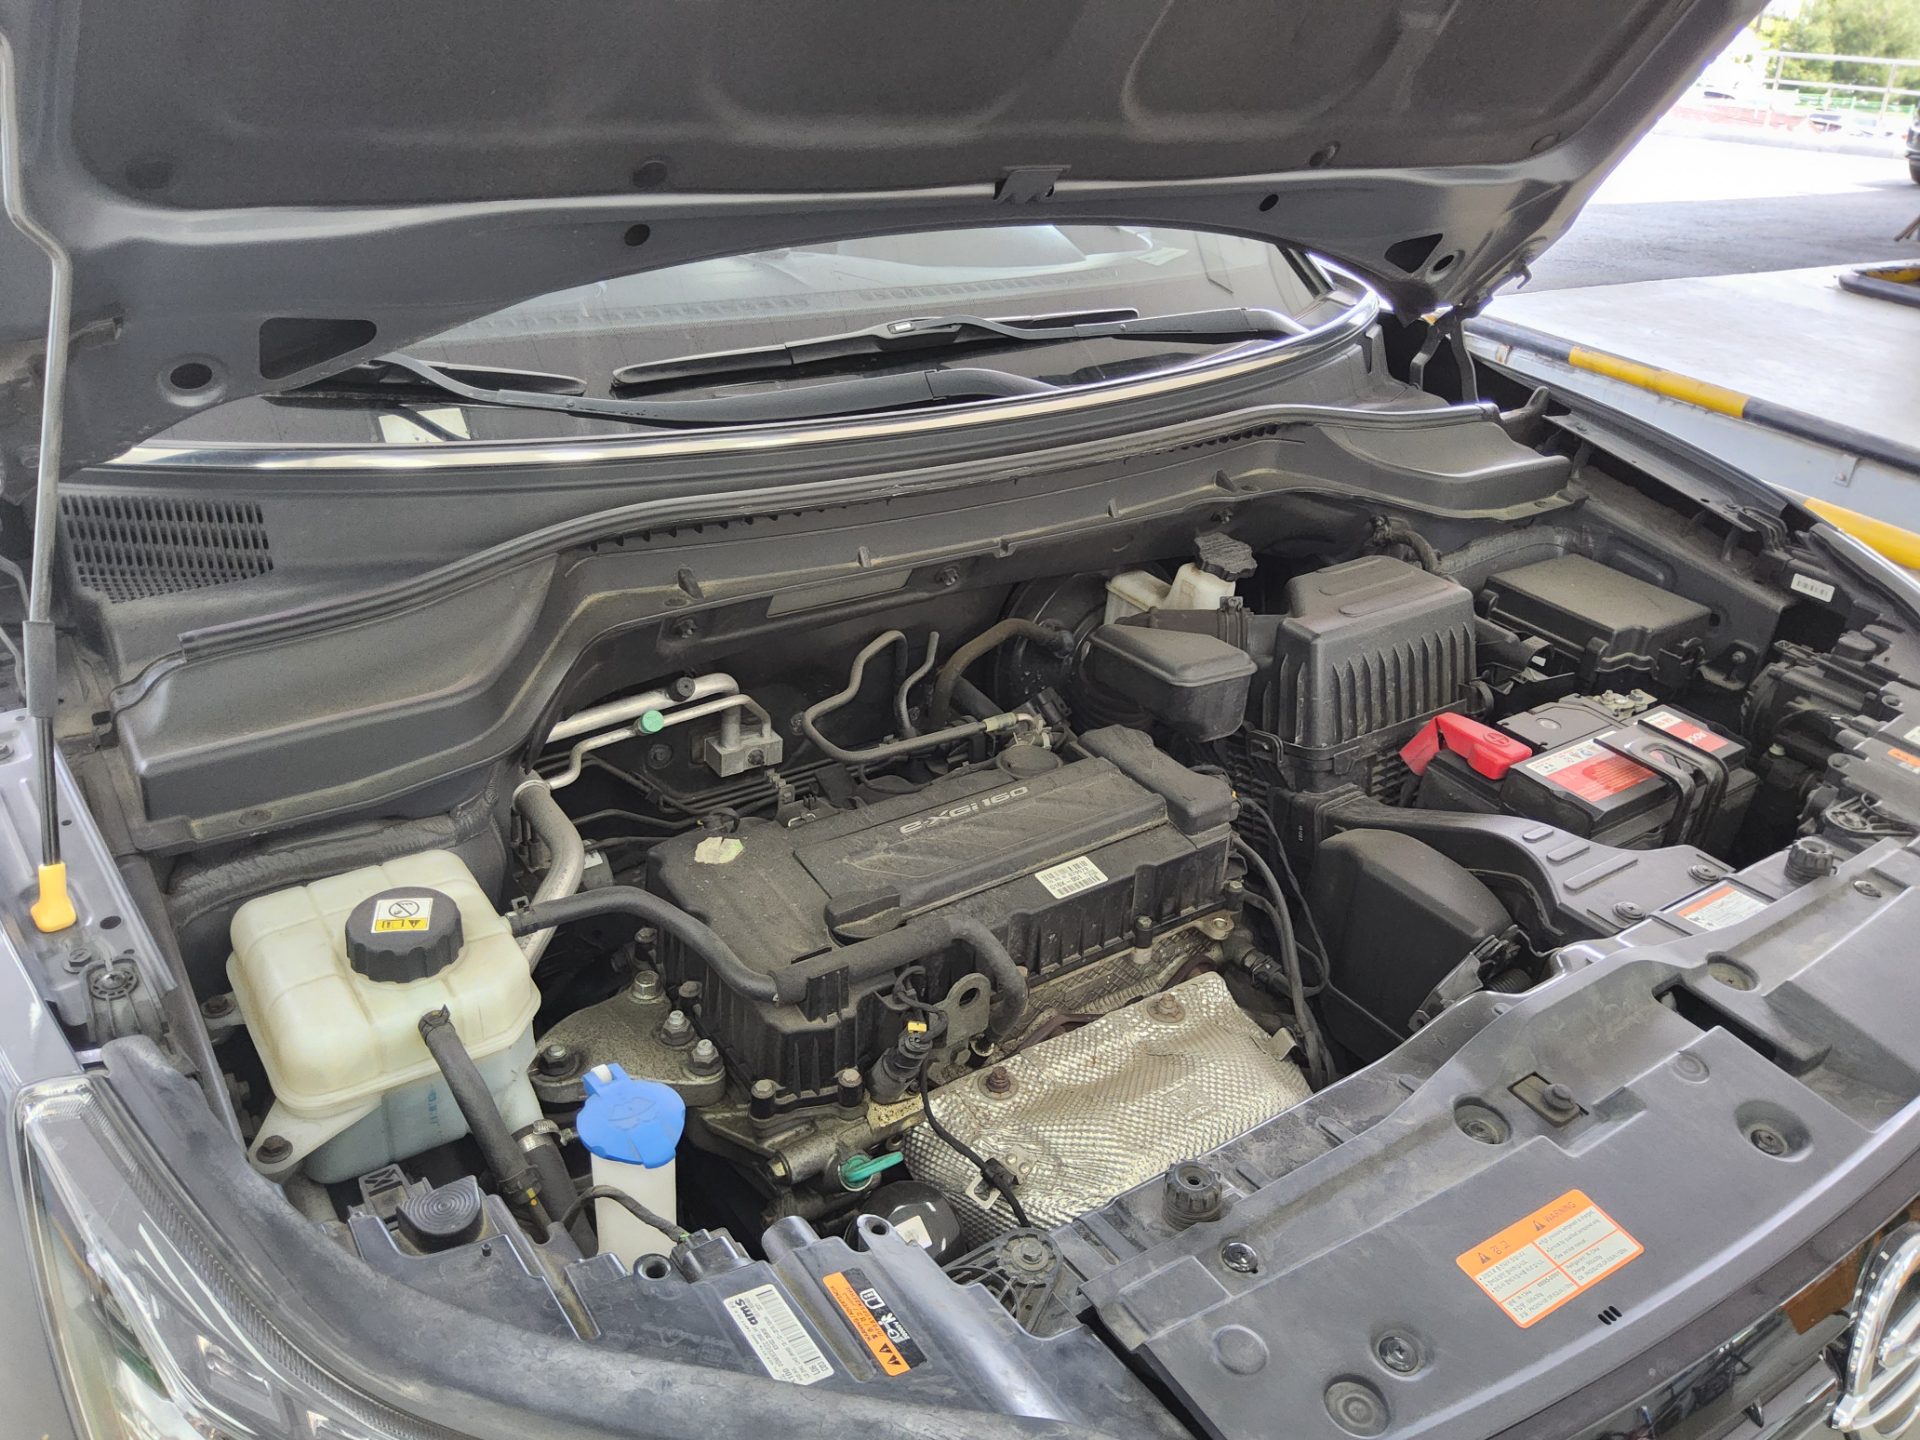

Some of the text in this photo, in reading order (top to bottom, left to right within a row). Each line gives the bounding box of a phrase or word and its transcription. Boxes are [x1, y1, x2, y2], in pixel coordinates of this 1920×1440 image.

[981, 787, 1028, 806] 160
[1544, 1201, 1577, 1223] WARNING
[735, 1298, 759, 1325] ams
